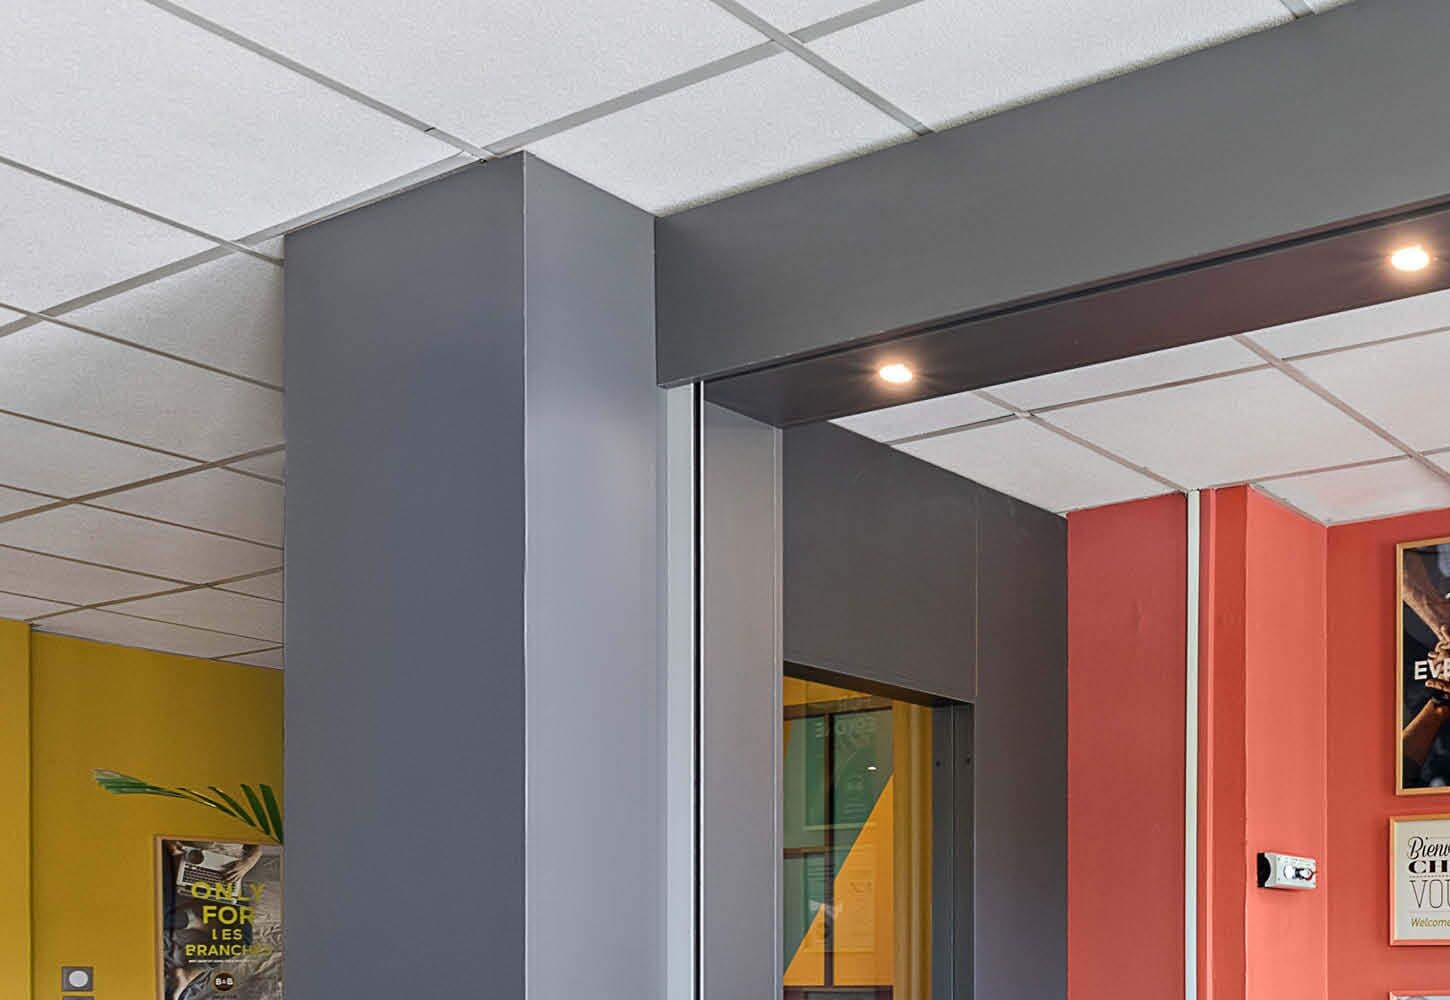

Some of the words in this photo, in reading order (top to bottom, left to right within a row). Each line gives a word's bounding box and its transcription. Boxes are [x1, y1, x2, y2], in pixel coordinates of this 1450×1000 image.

[192, 882, 264, 900] ONLY
[202, 905, 255, 925] FOR
[212, 929, 242, 940] LES
